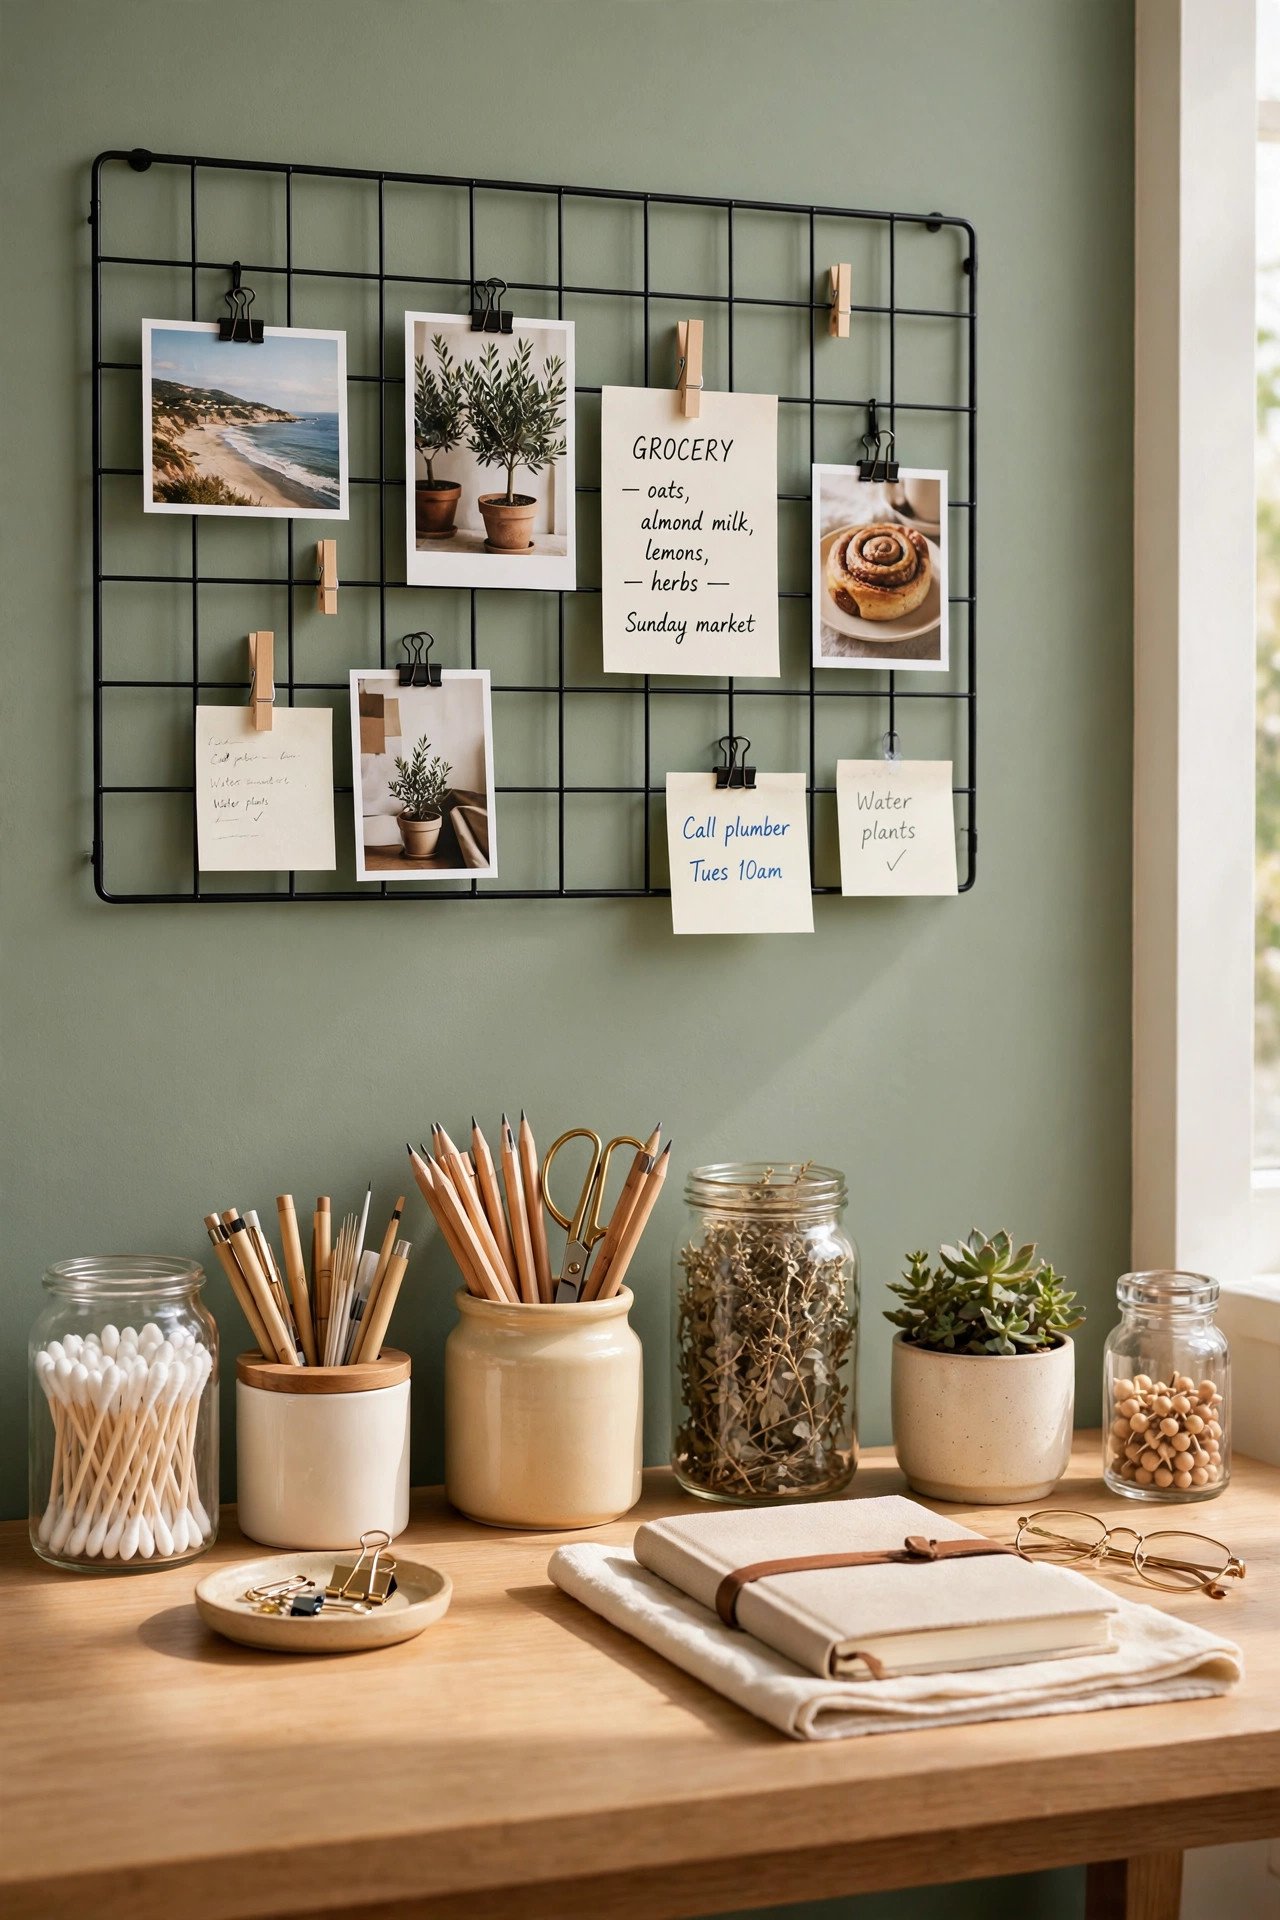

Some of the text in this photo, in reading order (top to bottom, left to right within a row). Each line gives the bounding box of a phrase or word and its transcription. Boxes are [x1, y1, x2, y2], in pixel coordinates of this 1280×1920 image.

[633, 436, 734, 462] GROCERY
[647, 480, 690, 504] oats,
[641, 509, 754, 536] almond milk,
[645, 538, 709, 565] lemons,
[651, 570, 698, 592] herbs
[625, 611, 756, 645] Sunday market
[857, 790, 912, 811] Water
[683, 816, 791, 847] Call plumber
[862, 820, 916, 850] plants
[689, 859, 782, 882] Tues 10am
